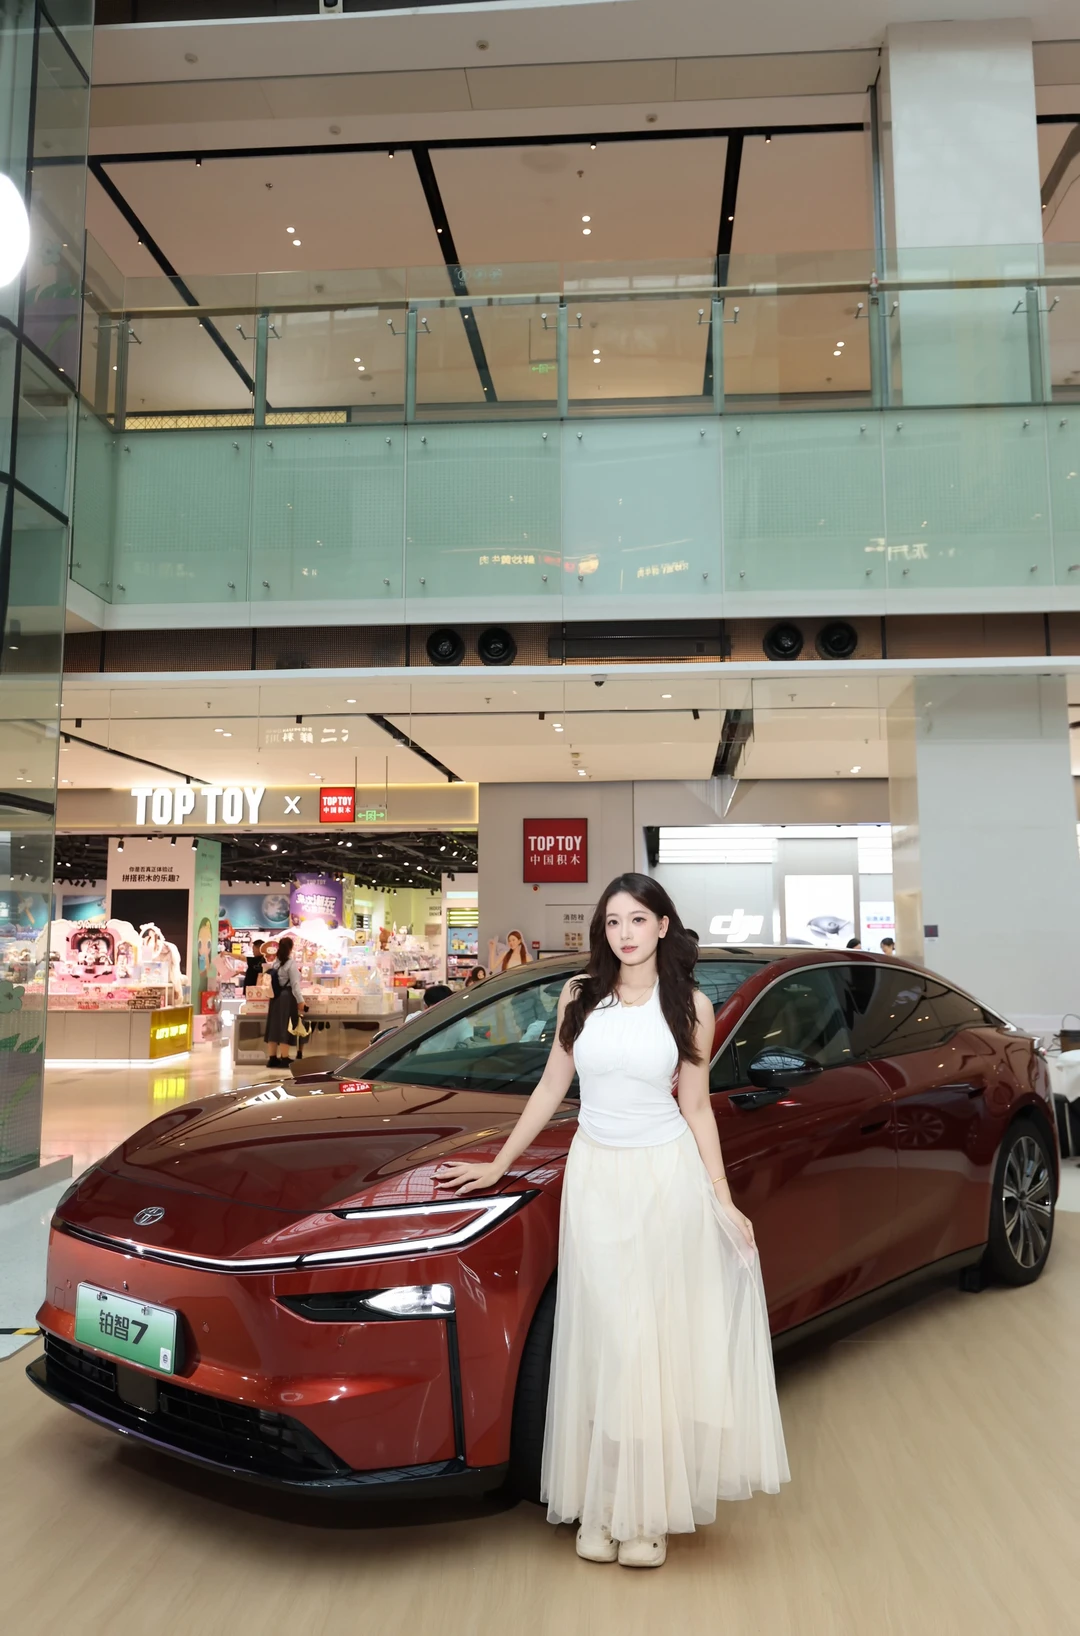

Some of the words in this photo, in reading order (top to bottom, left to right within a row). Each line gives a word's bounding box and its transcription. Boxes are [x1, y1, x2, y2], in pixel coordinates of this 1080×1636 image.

[131, 787, 195, 825] TOP
[201, 786, 266, 824] TOY
[322, 796, 338, 806] TOP
[337, 796, 353, 806] TOY
[323, 806, 352, 814] 中国积木
[528, 835, 555, 851] TOP
[555, 835, 582, 851] TOY
[530, 854, 580, 866] 中国积木
[563, 913, 584, 921] 消防栓
[99, 1309, 149, 1345] 铂智7
